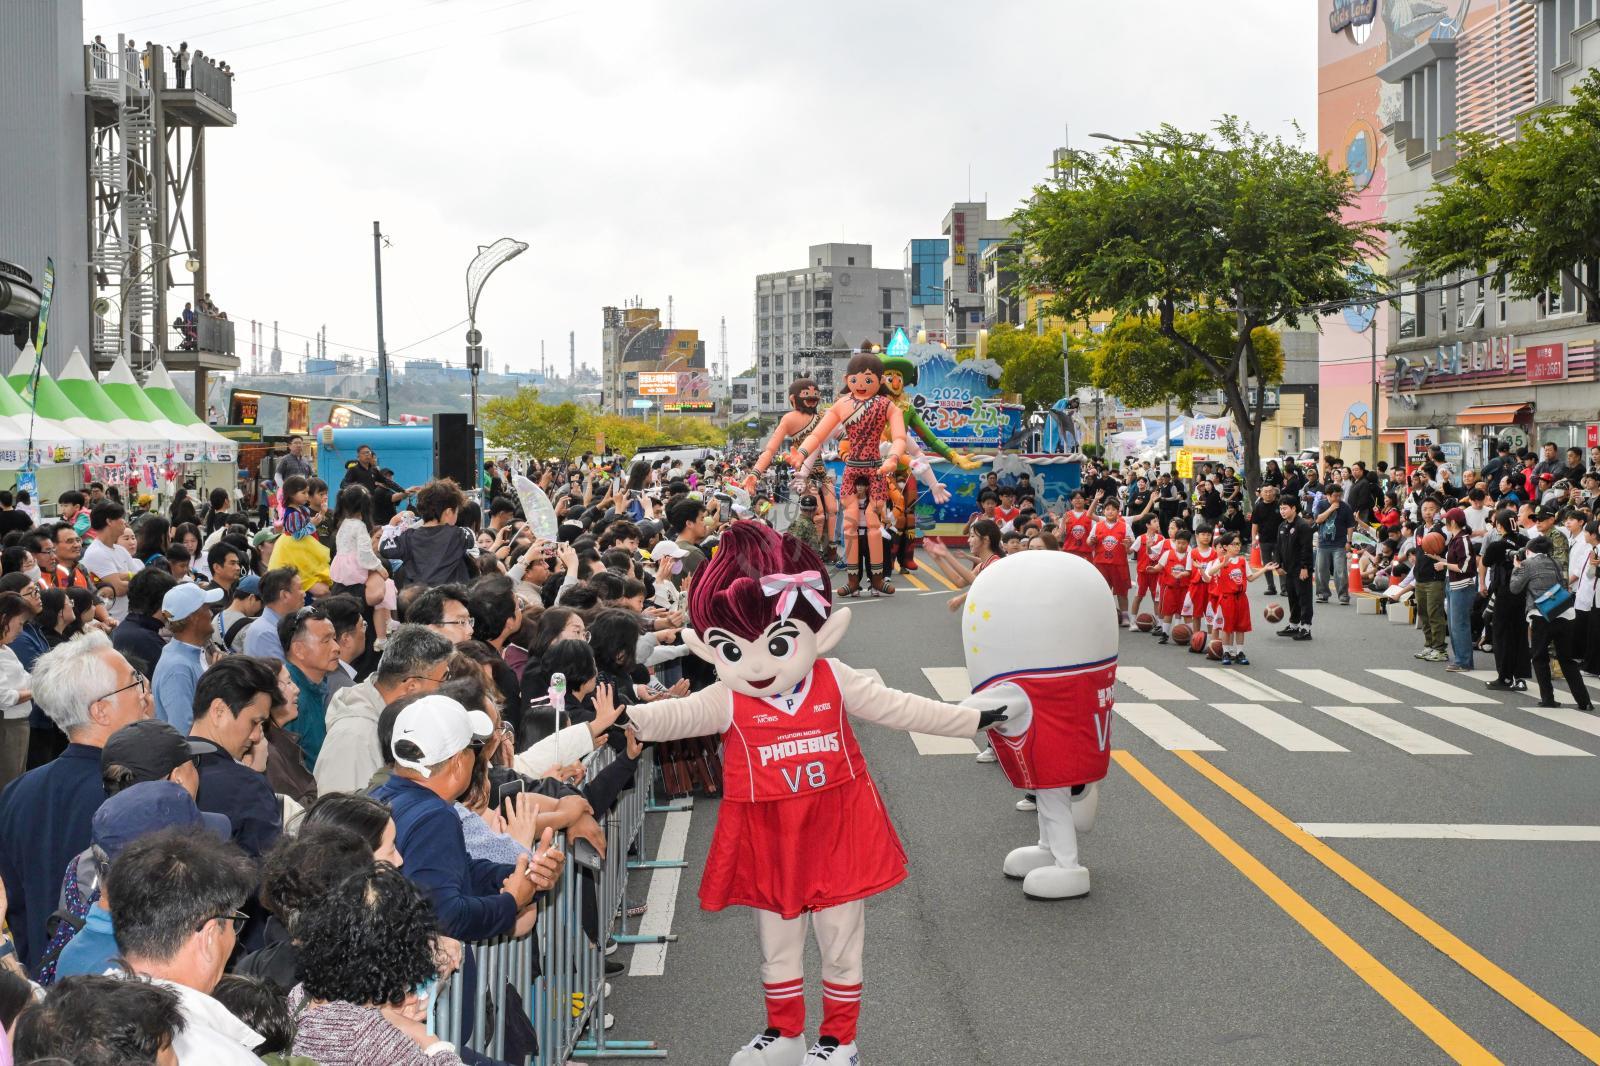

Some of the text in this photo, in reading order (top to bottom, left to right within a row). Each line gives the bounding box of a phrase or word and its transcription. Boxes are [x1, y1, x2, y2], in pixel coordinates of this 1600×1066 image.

[933, 388, 970, 401] 2026
[785, 698, 794, 710] P
[1094, 709, 1112, 752] V
[758, 731, 840, 767] PHOEBUS
[781, 761, 827, 793] V8
